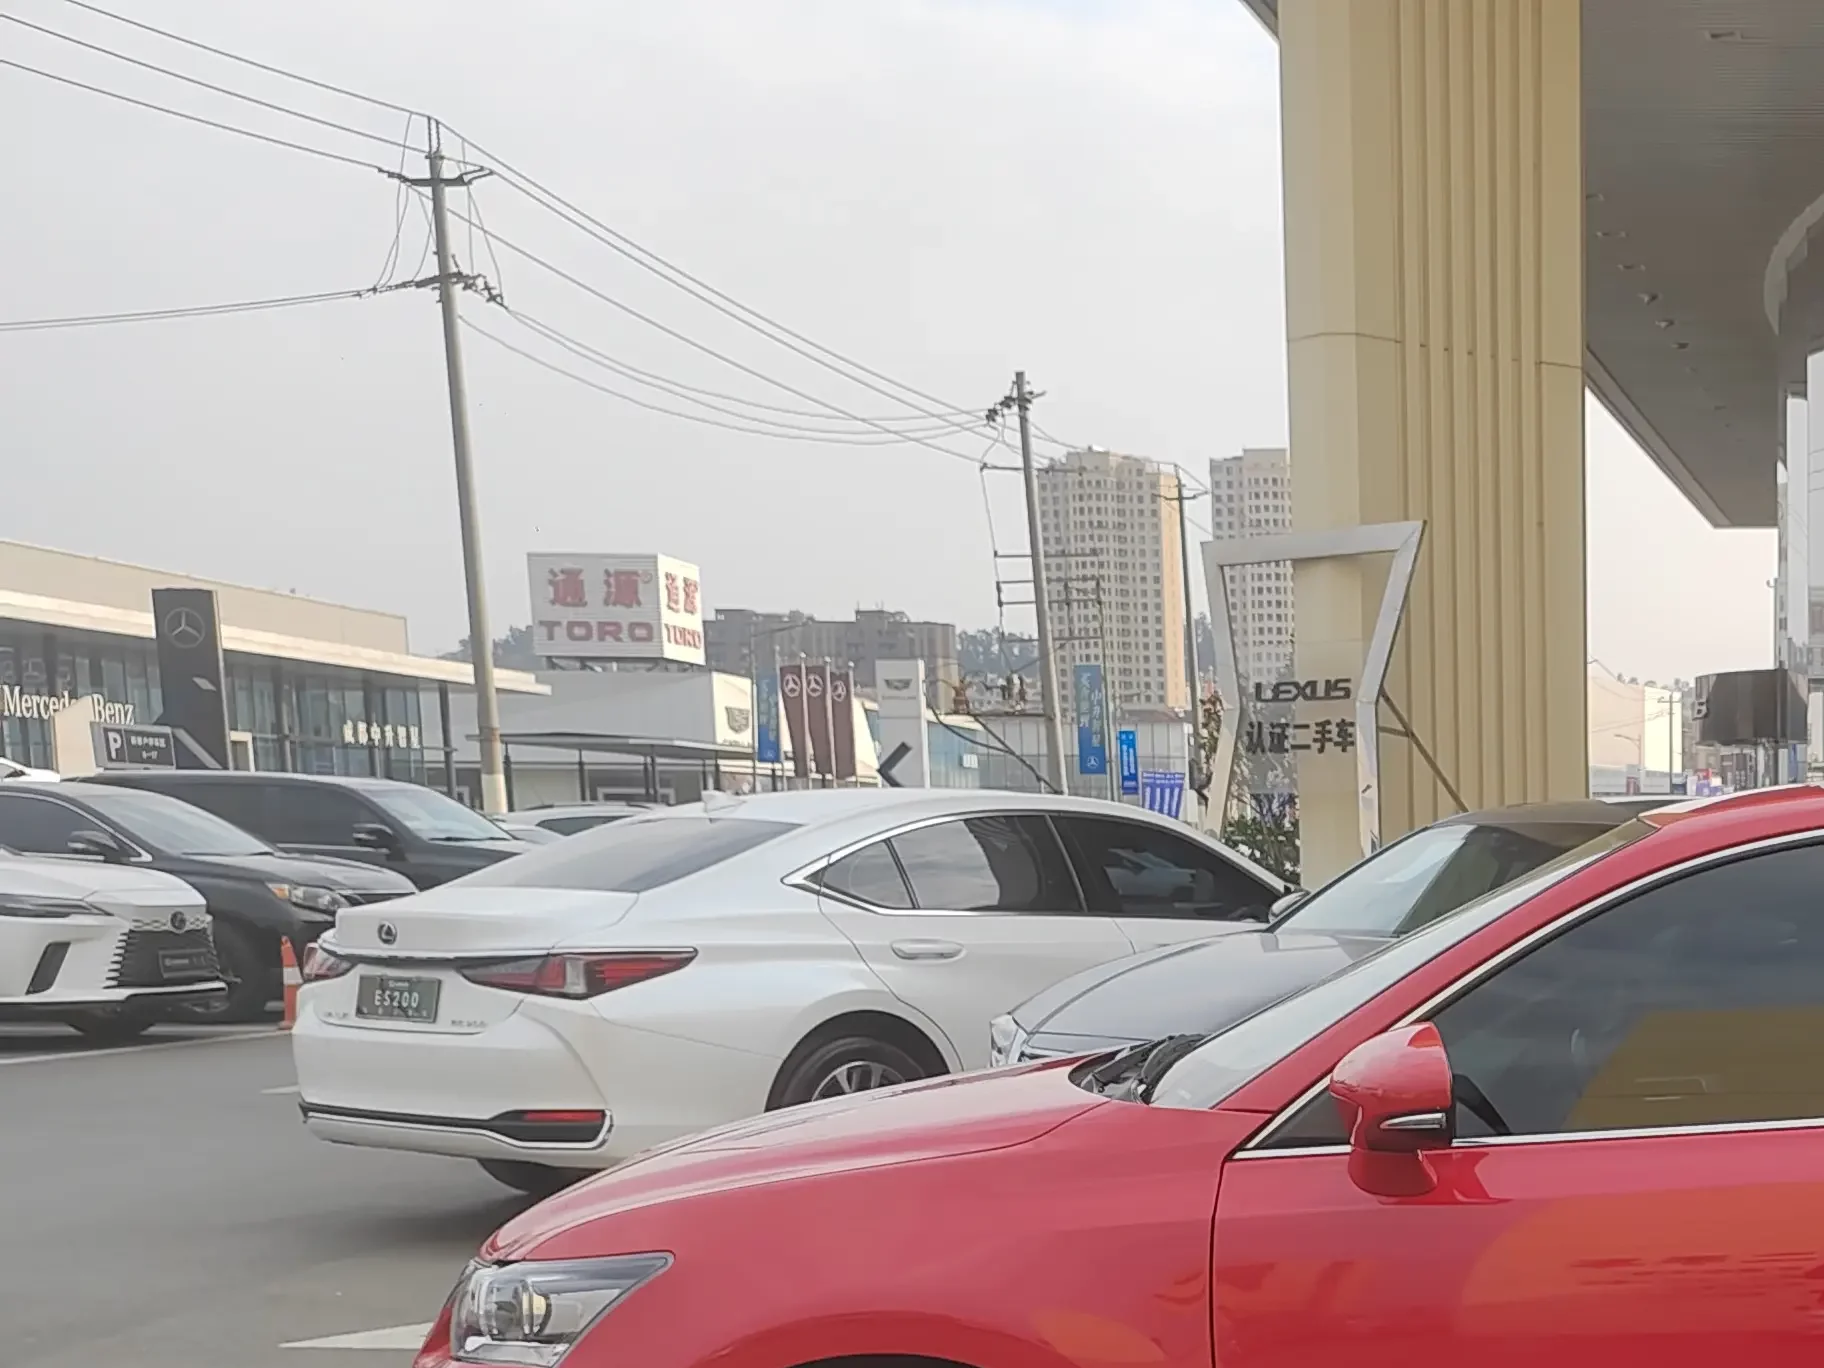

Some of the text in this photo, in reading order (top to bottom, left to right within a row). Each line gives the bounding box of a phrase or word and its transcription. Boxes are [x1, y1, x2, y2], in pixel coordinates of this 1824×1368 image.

[538, 620, 654, 642] TORO
[1254, 678, 1352, 702] LEXUS
[107, 731, 122, 760] P
[1245, 718, 1355, 754] 认证二手车
[374, 990, 419, 1008] ES200
